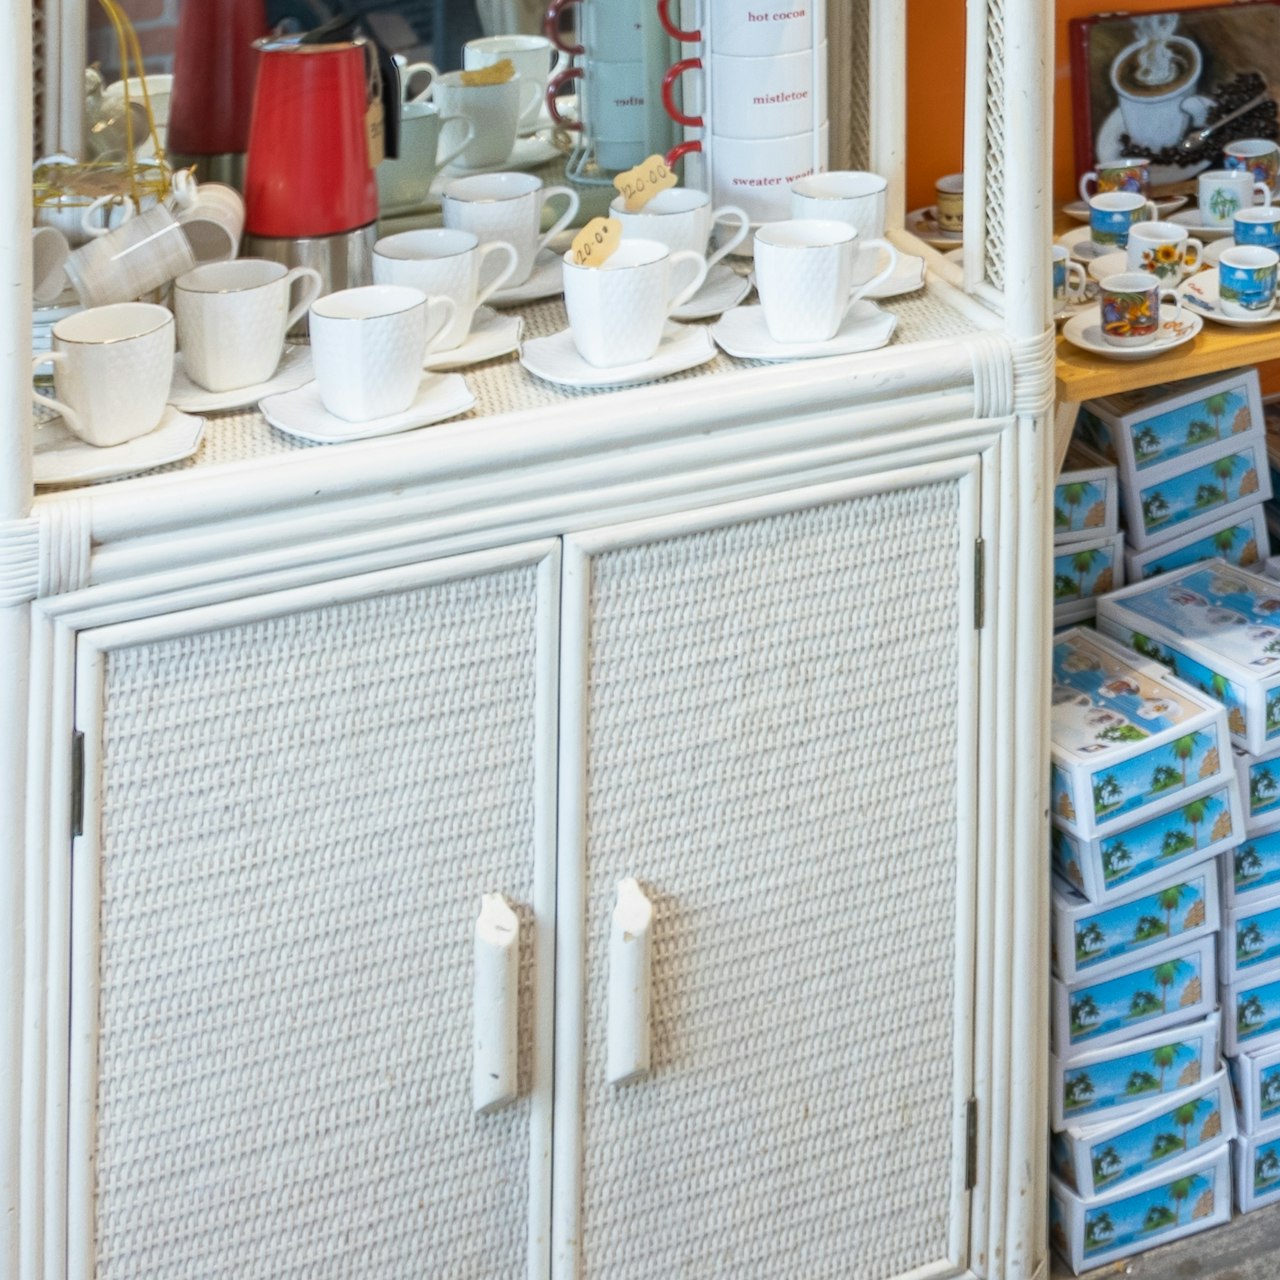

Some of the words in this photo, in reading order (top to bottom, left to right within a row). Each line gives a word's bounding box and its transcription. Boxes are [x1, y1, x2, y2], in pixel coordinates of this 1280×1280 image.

[748, 11, 769, 22] hot
[773, 9, 805, 21] cocoa
[753, 90, 808, 105] mistletoe
[732, 177, 782, 187] sweater
